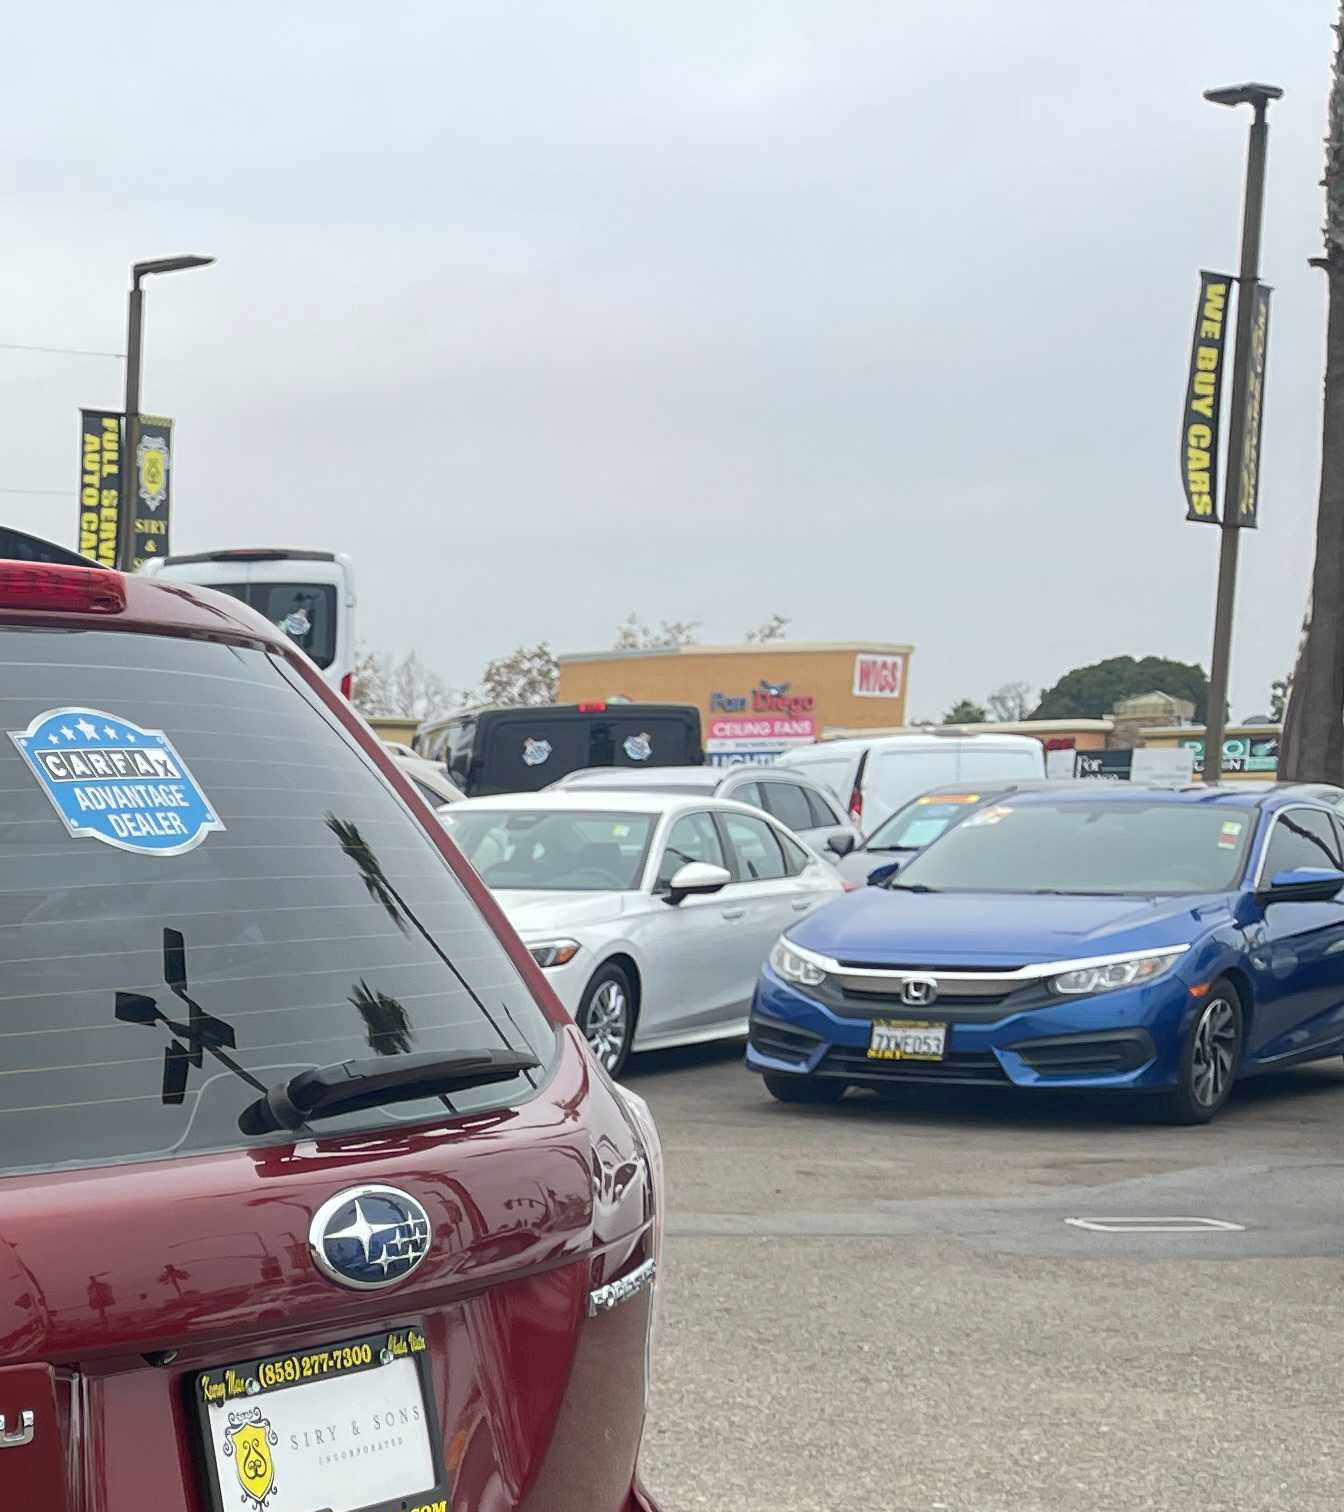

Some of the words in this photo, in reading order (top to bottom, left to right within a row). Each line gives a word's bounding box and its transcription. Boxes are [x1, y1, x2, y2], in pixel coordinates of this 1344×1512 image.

[1200, 283, 1226, 340] WE
[1191, 346, 1218, 418] BUY
[102, 417, 119, 477] FULL
[82, 433, 101, 506] AUTO
[1187, 424, 1213, 516] CARS
[79, 512, 99, 560] CAR
[134, 519, 167, 535] SIRY
[144, 539, 157, 553] &
[858, 659, 899, 693] WIGS
[752, 689, 814, 718] Diego
[713, 722, 771, 737] CEILING
[774, 720, 812, 734] FANS
[45, 751, 178, 778] CARFAX
[73, 784, 191, 811] ADVANTAGE
[108, 812, 189, 838] DEALER
[288, 1424, 338, 1451] SIRY
[350, 1420, 361, 1436] &
[373, 1404, 421, 1431] SONS
